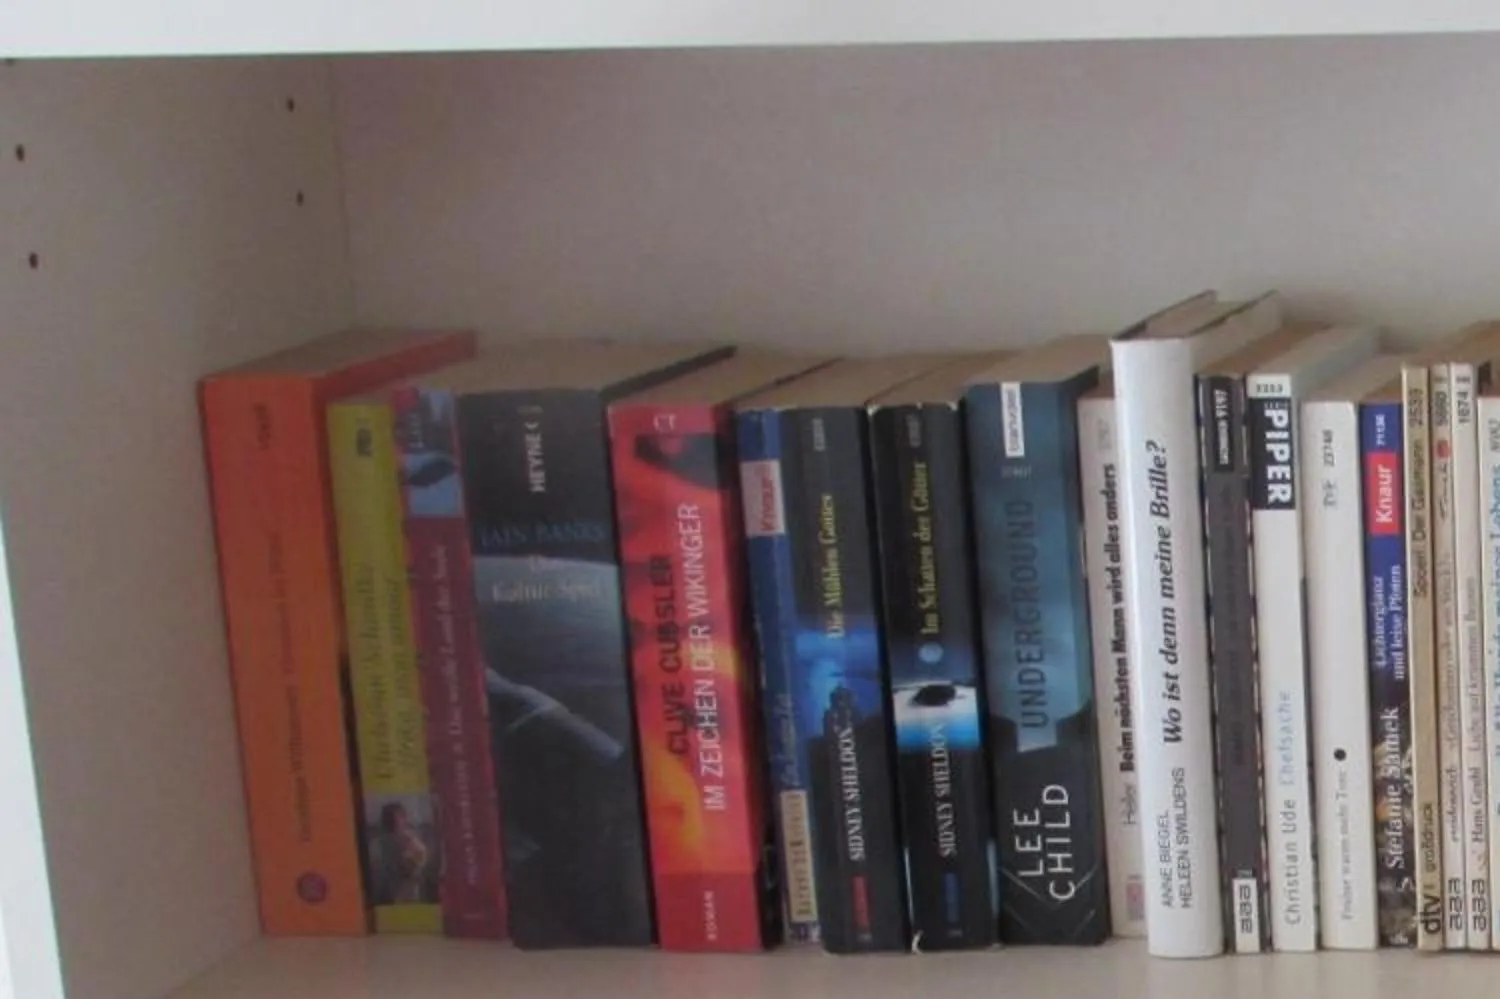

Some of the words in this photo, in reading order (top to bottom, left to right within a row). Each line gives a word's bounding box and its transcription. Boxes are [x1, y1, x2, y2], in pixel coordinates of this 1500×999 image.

[527, 432, 546, 492] HEYNE
[907, 461, 929, 511] Götter
[1145, 440, 1172, 520] Brille?
[1262, 410, 1293, 504] PIPER
[817, 493, 837, 544] Gottes
[1374, 464, 1394, 524] Knaur
[911, 514, 931, 541] der
[678, 503, 710, 616] WIKINGER
[822, 547, 843, 606] Mühlen
[915, 544, 938, 609] Schatten
[1153, 525, 1176, 599] meine
[650, 554, 683, 673] CUSSLER
[827, 609, 846, 640] Die
[920, 614, 938, 634] Im
[1005, 500, 1051, 728] UNDERGROUND
[1155, 607, 1180, 665] denn
[690, 625, 714, 672] DER
[1158, 671, 1182, 702] ist
[663, 684, 690, 755] CLIVE
[696, 679, 724, 779] ZEICHEN
[1162, 708, 1184, 743] Wo
[1275, 691, 1295, 786] Chefsache
[1377, 707, 1401, 780] Samek
[840, 726, 862, 800] SHELDON
[928, 720, 953, 799] SHELDON
[701, 784, 727, 811] IM
[1172, 767, 1190, 845] SWILDENS
[1278, 799, 1297, 835] Ude
[1380, 784, 1404, 869] Stefanie
[844, 804, 866, 861] SIDNEY
[934, 802, 957, 857] SIDNEY
[1010, 808, 1043, 877] LEE
[1040, 783, 1078, 901] CHILD
[1156, 811, 1174, 864] BIEGEL
[1162, 868, 1175, 907] ANNE
[1175, 849, 1193, 907] HELEEN
[1281, 842, 1301, 924] Christian
[1417, 894, 1442, 934] dtv
